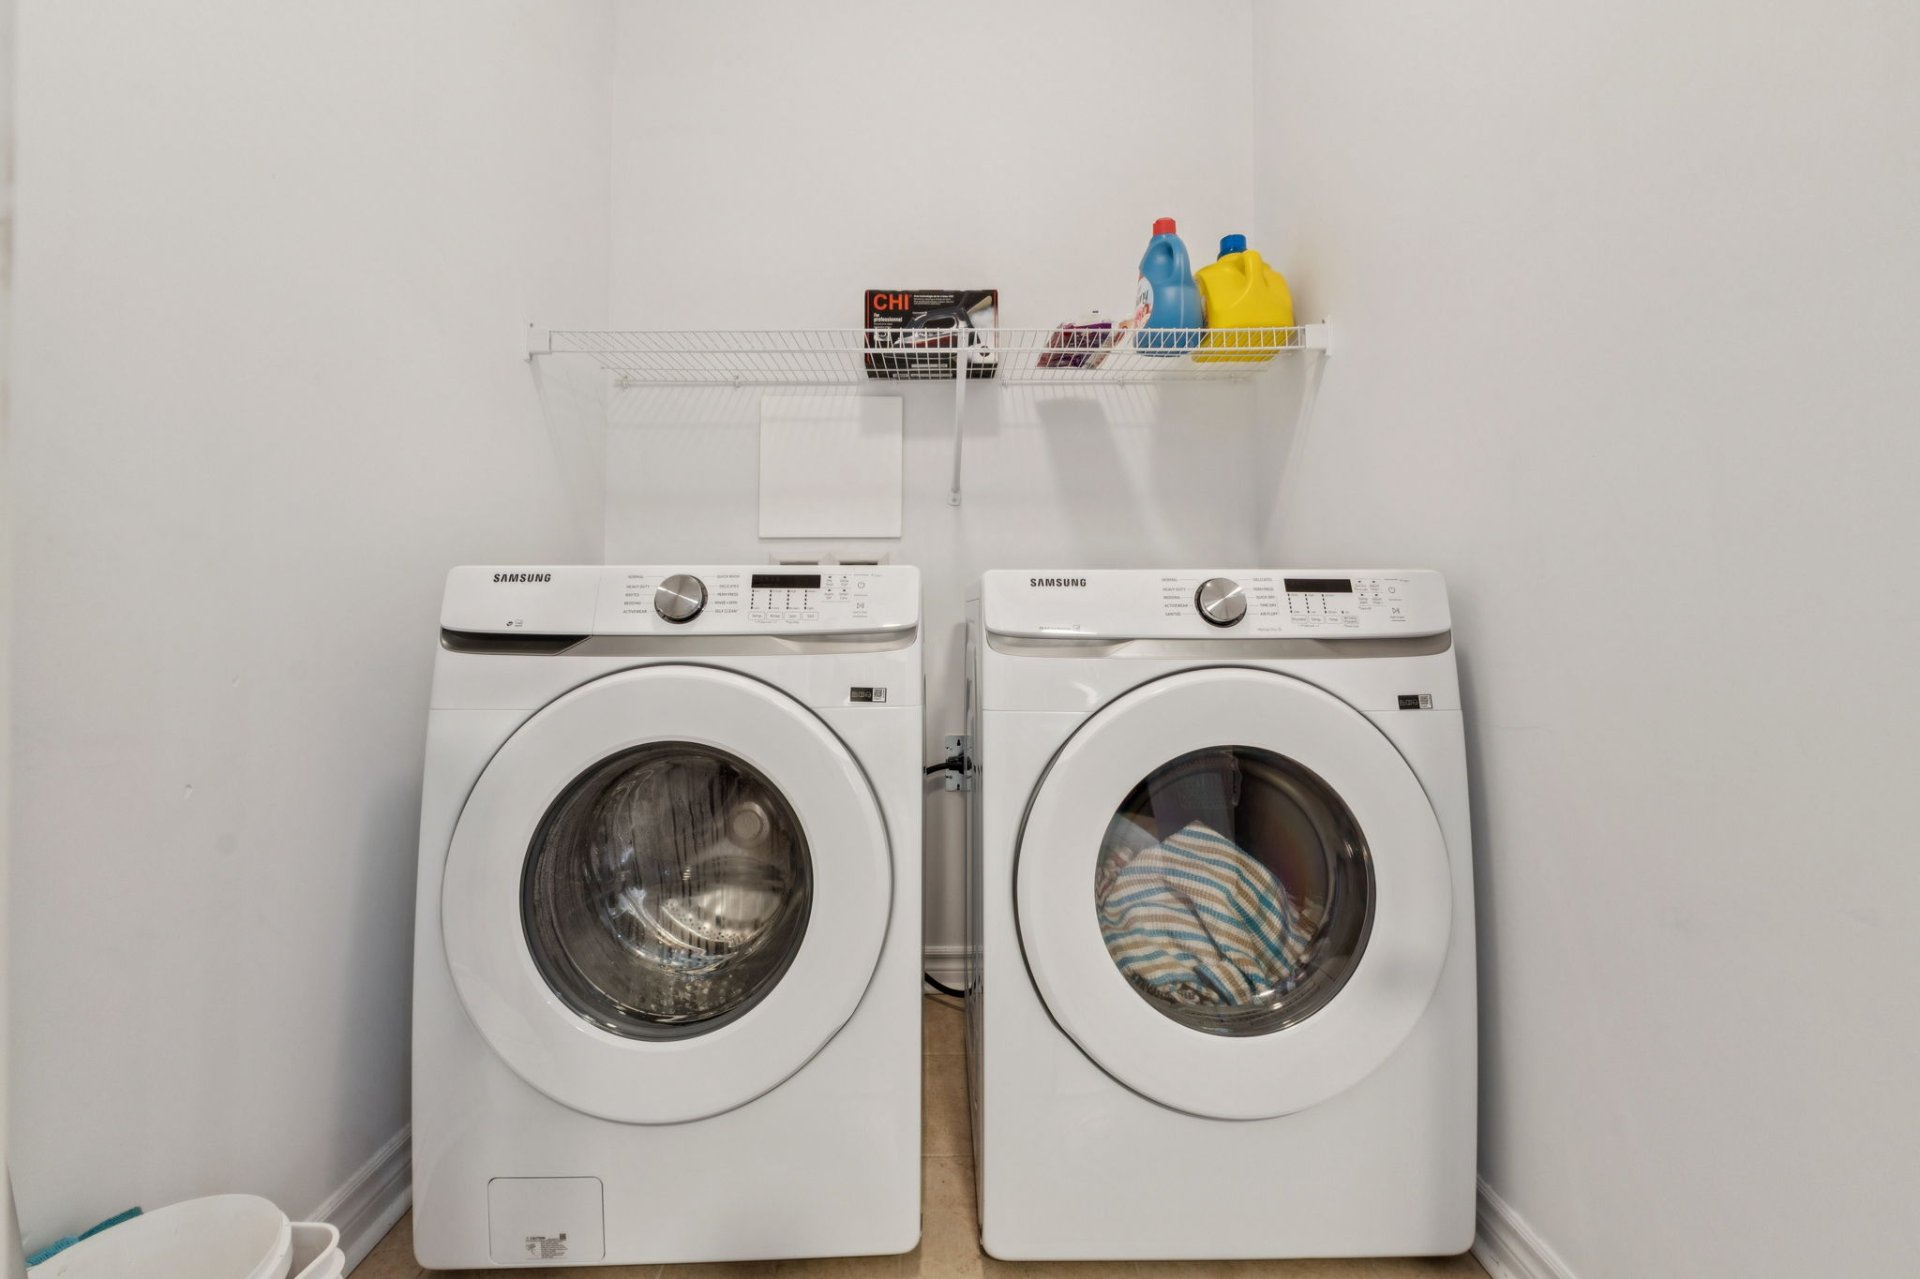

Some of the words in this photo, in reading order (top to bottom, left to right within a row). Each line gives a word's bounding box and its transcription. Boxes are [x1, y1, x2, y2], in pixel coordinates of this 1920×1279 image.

[873, 293, 909, 310] CHI
[493, 573, 552, 583] SAMSUNG
[1030, 578, 1087, 588] SAMSUNG
